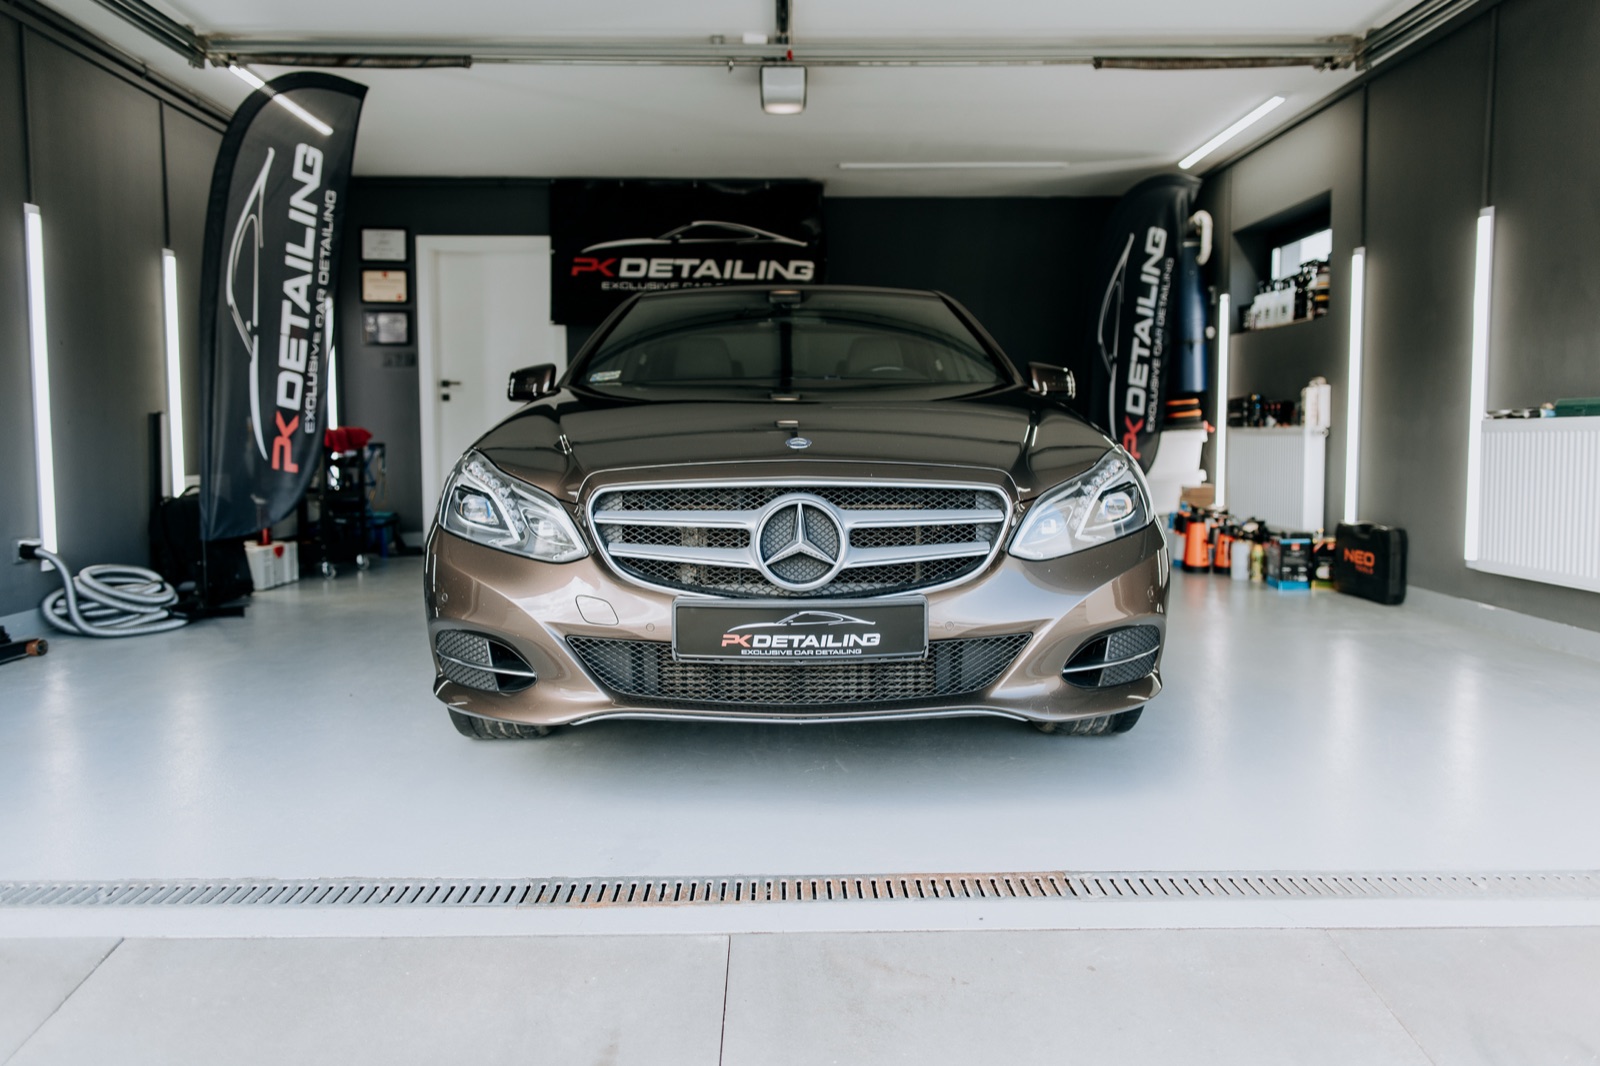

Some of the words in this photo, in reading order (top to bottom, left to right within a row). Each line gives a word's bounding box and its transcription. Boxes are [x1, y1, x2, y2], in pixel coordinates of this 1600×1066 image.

[317, 189, 337, 286] DETAILING
[601, 281, 680, 291] EXCLUSIVE
[314, 287, 328, 329] CAR
[1146, 358, 1161, 433] EXCLUSIVE
[1155, 257, 1175, 327] DETAILING
[304, 331, 322, 434] EXCLUSIVE
[1343, 548, 1375, 567] NEO
[741, 648, 793, 656] EXCLUSIVE
[794, 648, 815, 656] CAR
[815, 648, 862, 656] DETAILING
